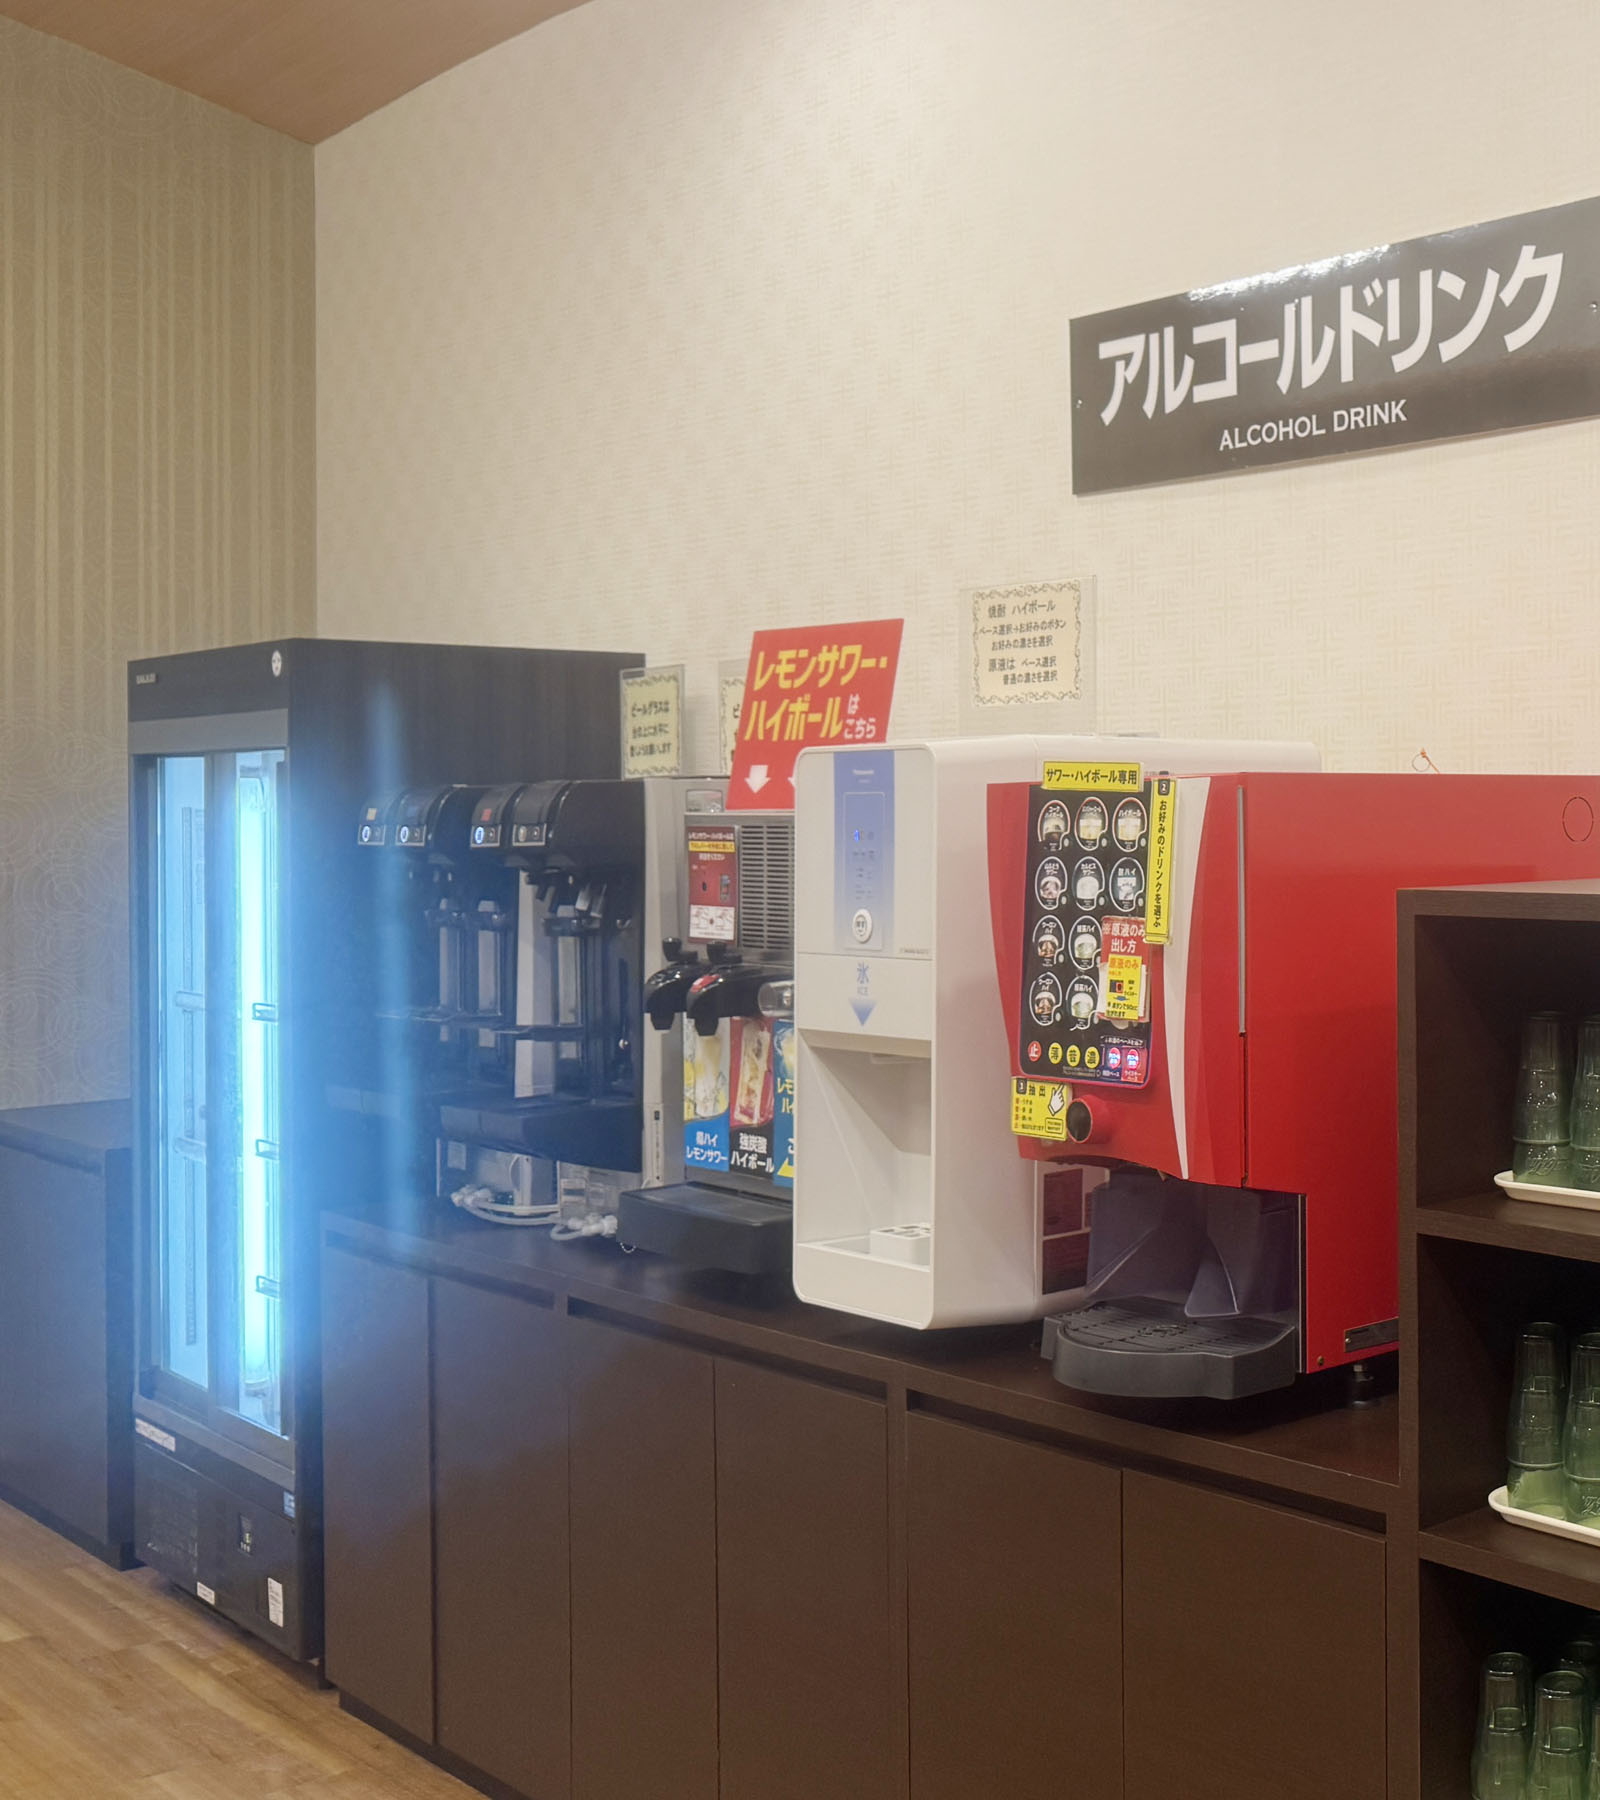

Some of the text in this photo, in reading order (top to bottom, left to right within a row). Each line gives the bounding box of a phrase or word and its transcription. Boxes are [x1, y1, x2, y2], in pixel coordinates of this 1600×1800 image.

[1099, 245, 1564, 426] アルコールドリンク
[1219, 399, 1407, 451] ALCOHOL DRINK
[1011, 600, 1056, 615] ハイボール
[744, 694, 843, 741] ハイボール
[847, 694, 859, 714] は
[844, 718, 876, 739] こちら
[1046, 769, 1138, 785] サワー・ハイボール専用
[1153, 800, 1168, 928] お好みのドリンクを選ぶ
[1111, 938, 1137, 954] 出し方
[856, 962, 870, 985] 氷
[1029, 1043, 1039, 1057] 止
[686, 1146, 728, 1163] レモンサワー
[731, 1151, 774, 1173] ハイボール
